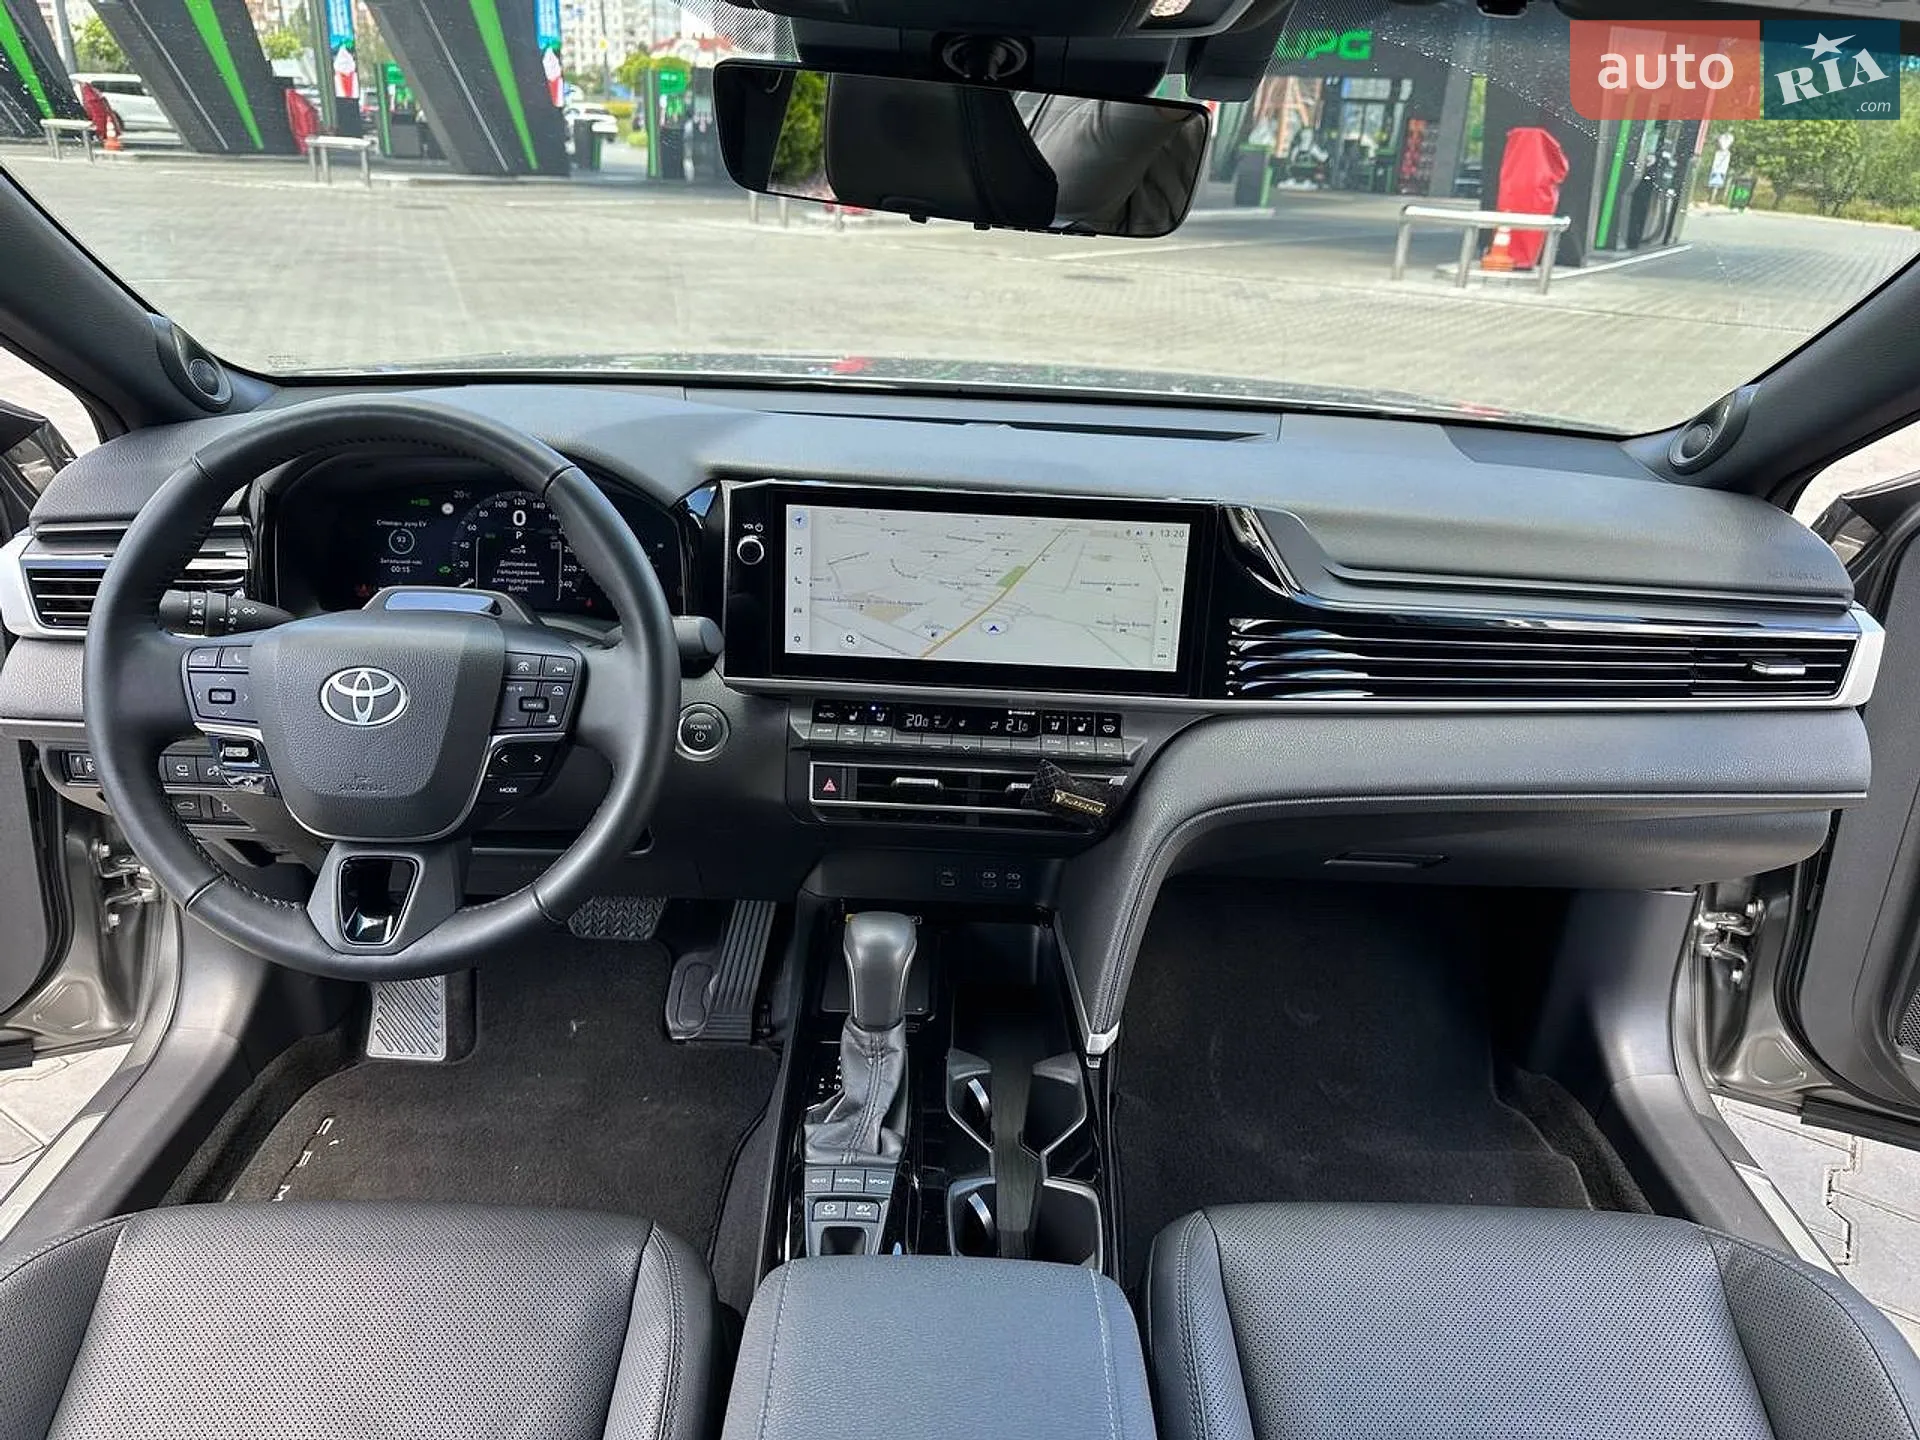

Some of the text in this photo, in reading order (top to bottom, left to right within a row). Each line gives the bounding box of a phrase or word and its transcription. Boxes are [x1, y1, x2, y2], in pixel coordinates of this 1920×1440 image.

[514, 498, 526, 506] 120
[479, 510, 488, 518] 80
[512, 510, 527, 526] 0
[515, 531, 523, 539] P
